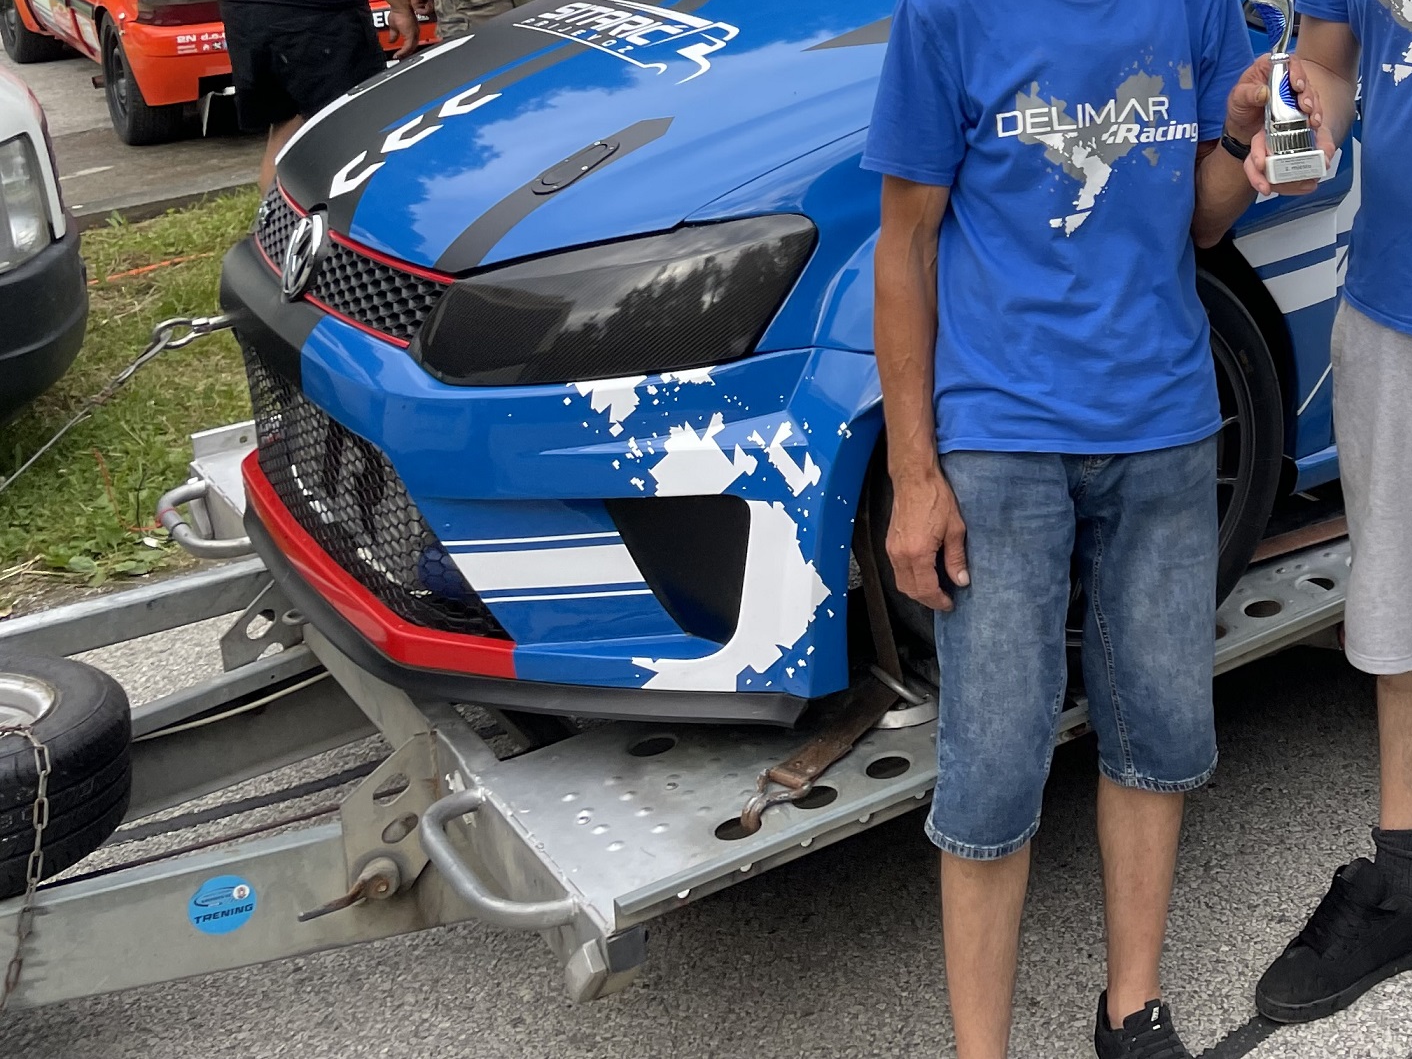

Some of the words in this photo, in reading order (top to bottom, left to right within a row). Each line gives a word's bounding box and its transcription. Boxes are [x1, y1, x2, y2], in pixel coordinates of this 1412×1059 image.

[521, 17, 634, 53] PRIJEVOZ
[996, 95, 1170, 138] DELIMAR
[1101, 120, 1198, 145] Racing
[194, 903, 254, 924] TRENING
